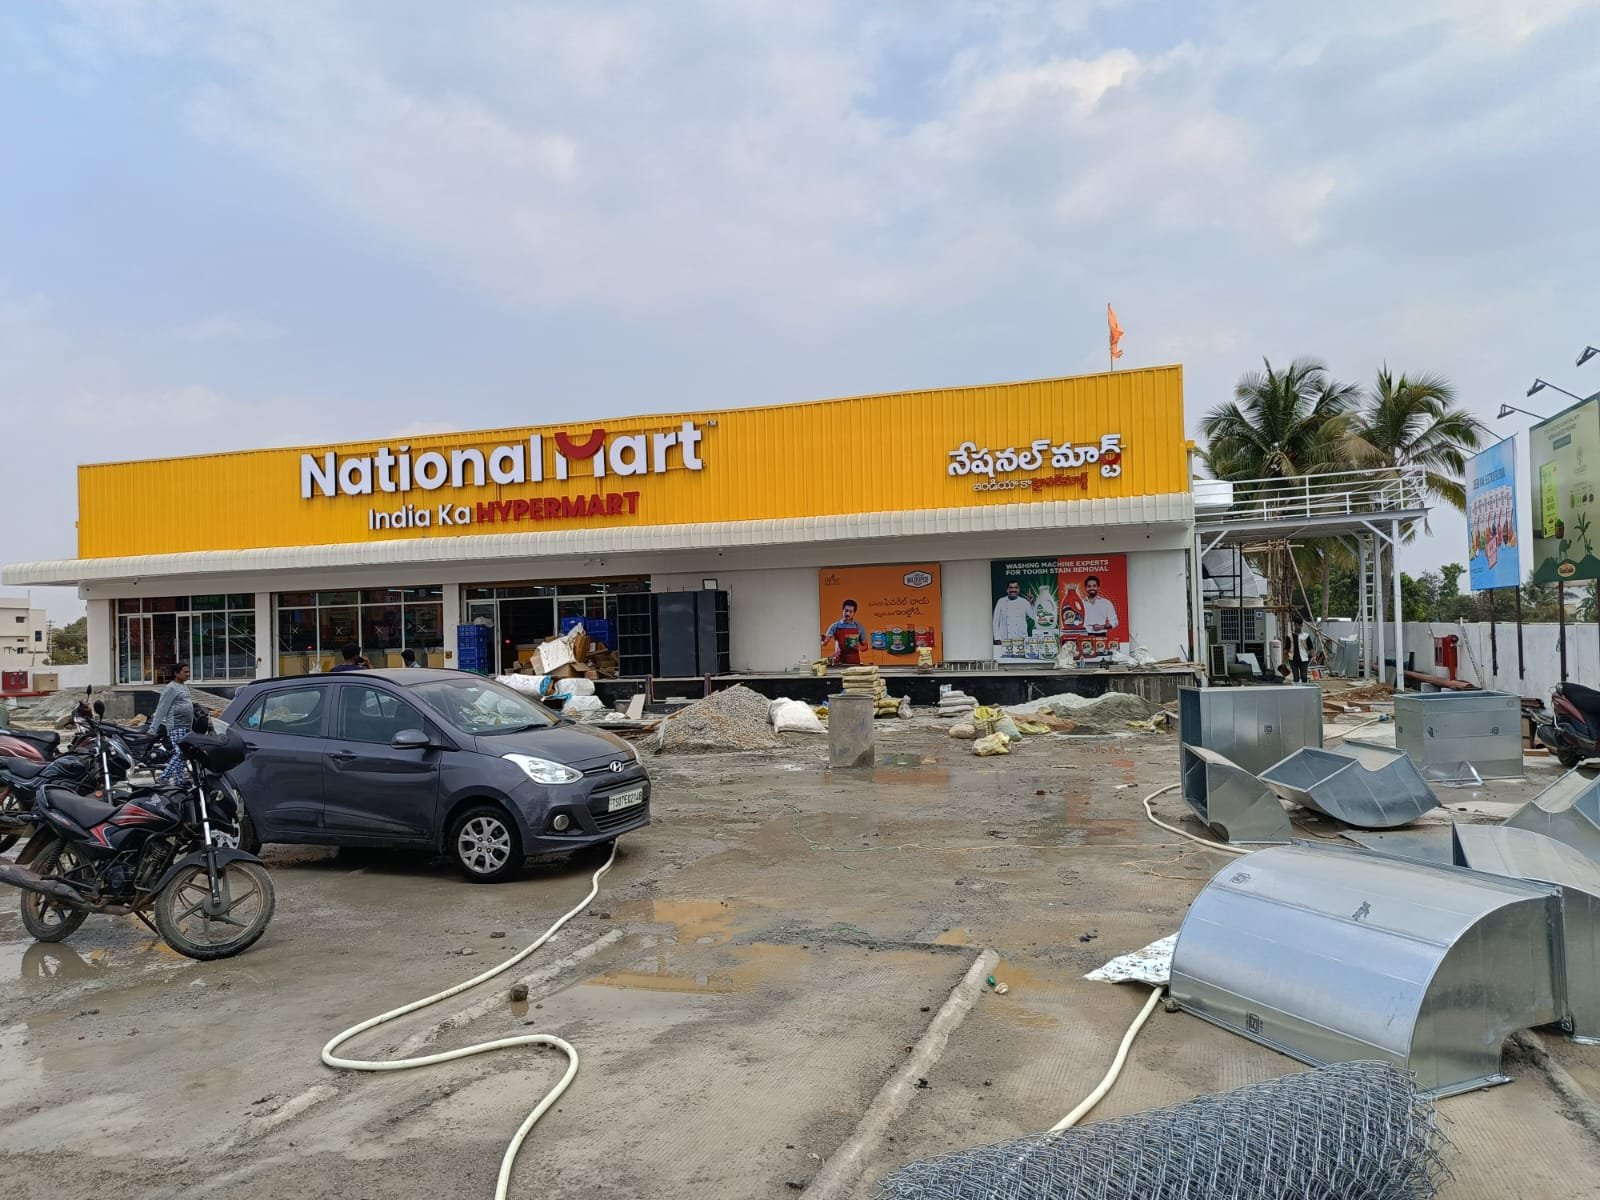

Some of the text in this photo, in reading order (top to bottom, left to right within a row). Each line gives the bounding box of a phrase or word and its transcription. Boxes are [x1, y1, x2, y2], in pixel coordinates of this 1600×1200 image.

[301, 434, 544, 499] National
[554, 421, 704, 480] Mart
[947, 433, 1122, 478] నేషనల్ మార్ట్
[368, 491, 641, 530] India Ka HYPERMART
[1005, 562, 1040, 570] WASHING
[1075, 559, 1109, 567] EXPERTS
